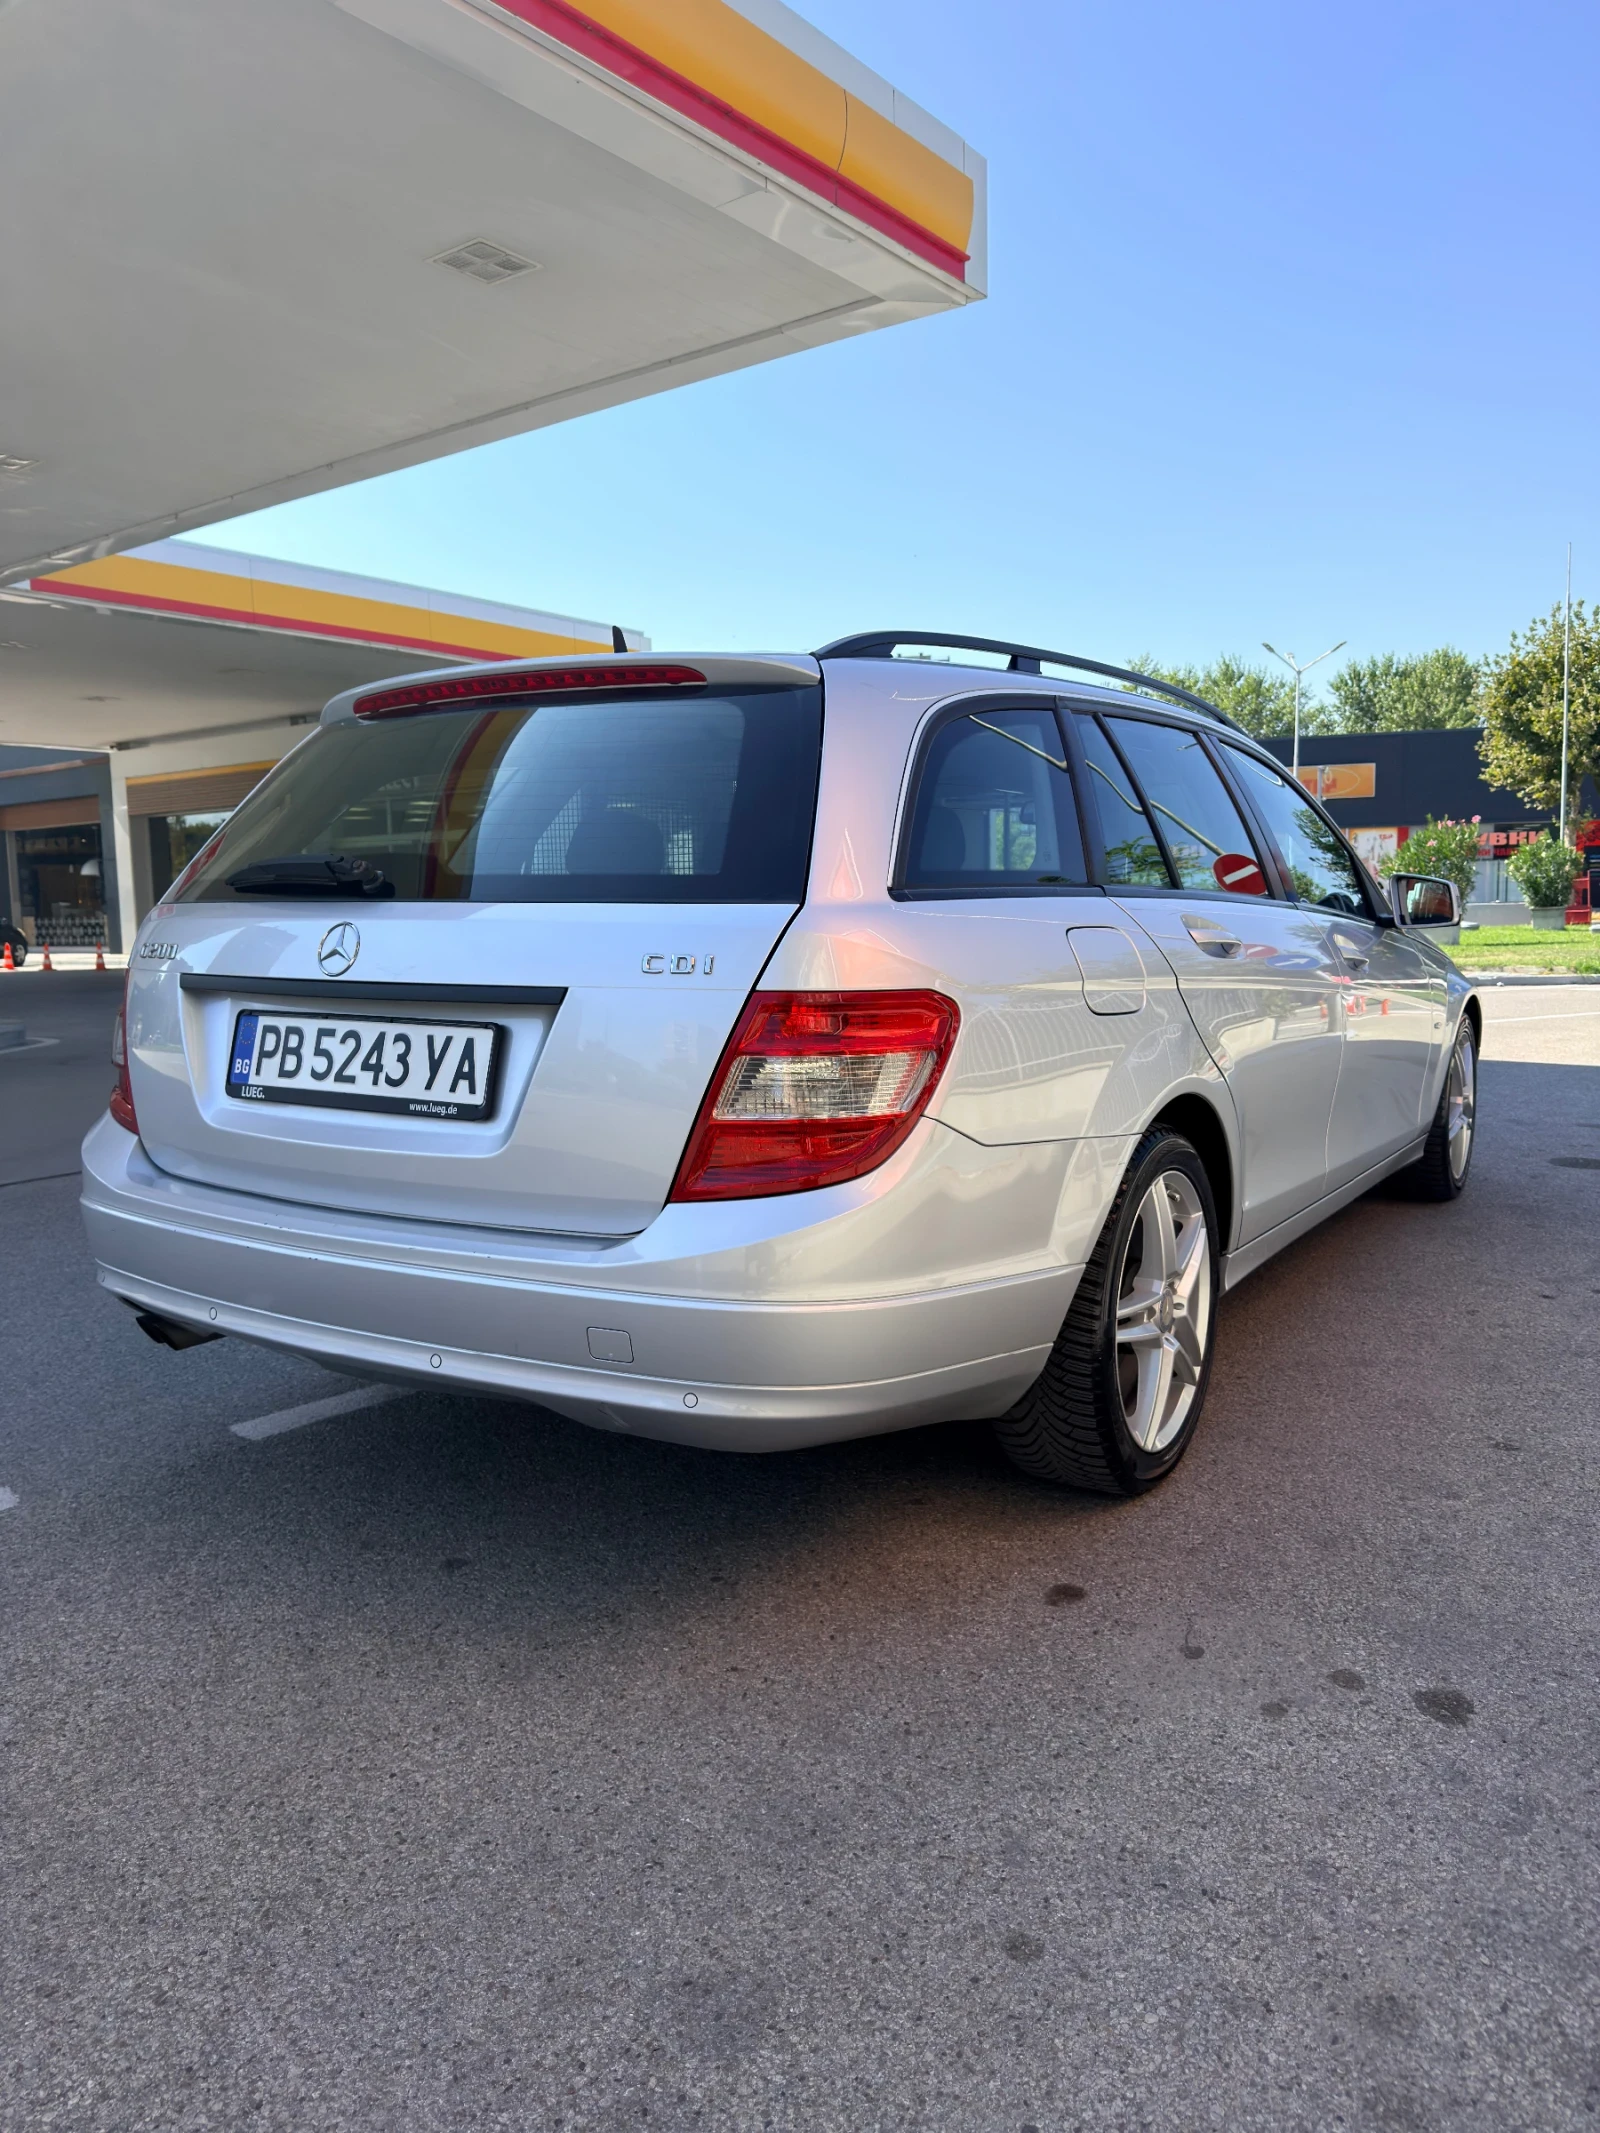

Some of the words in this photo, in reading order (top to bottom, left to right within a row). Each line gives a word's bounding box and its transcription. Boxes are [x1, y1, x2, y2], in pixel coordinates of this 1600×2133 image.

[642, 953, 714, 975] CDI
[234, 1059, 250, 1074] BG
[409, 1103, 458, 1116] www.lueg.de
